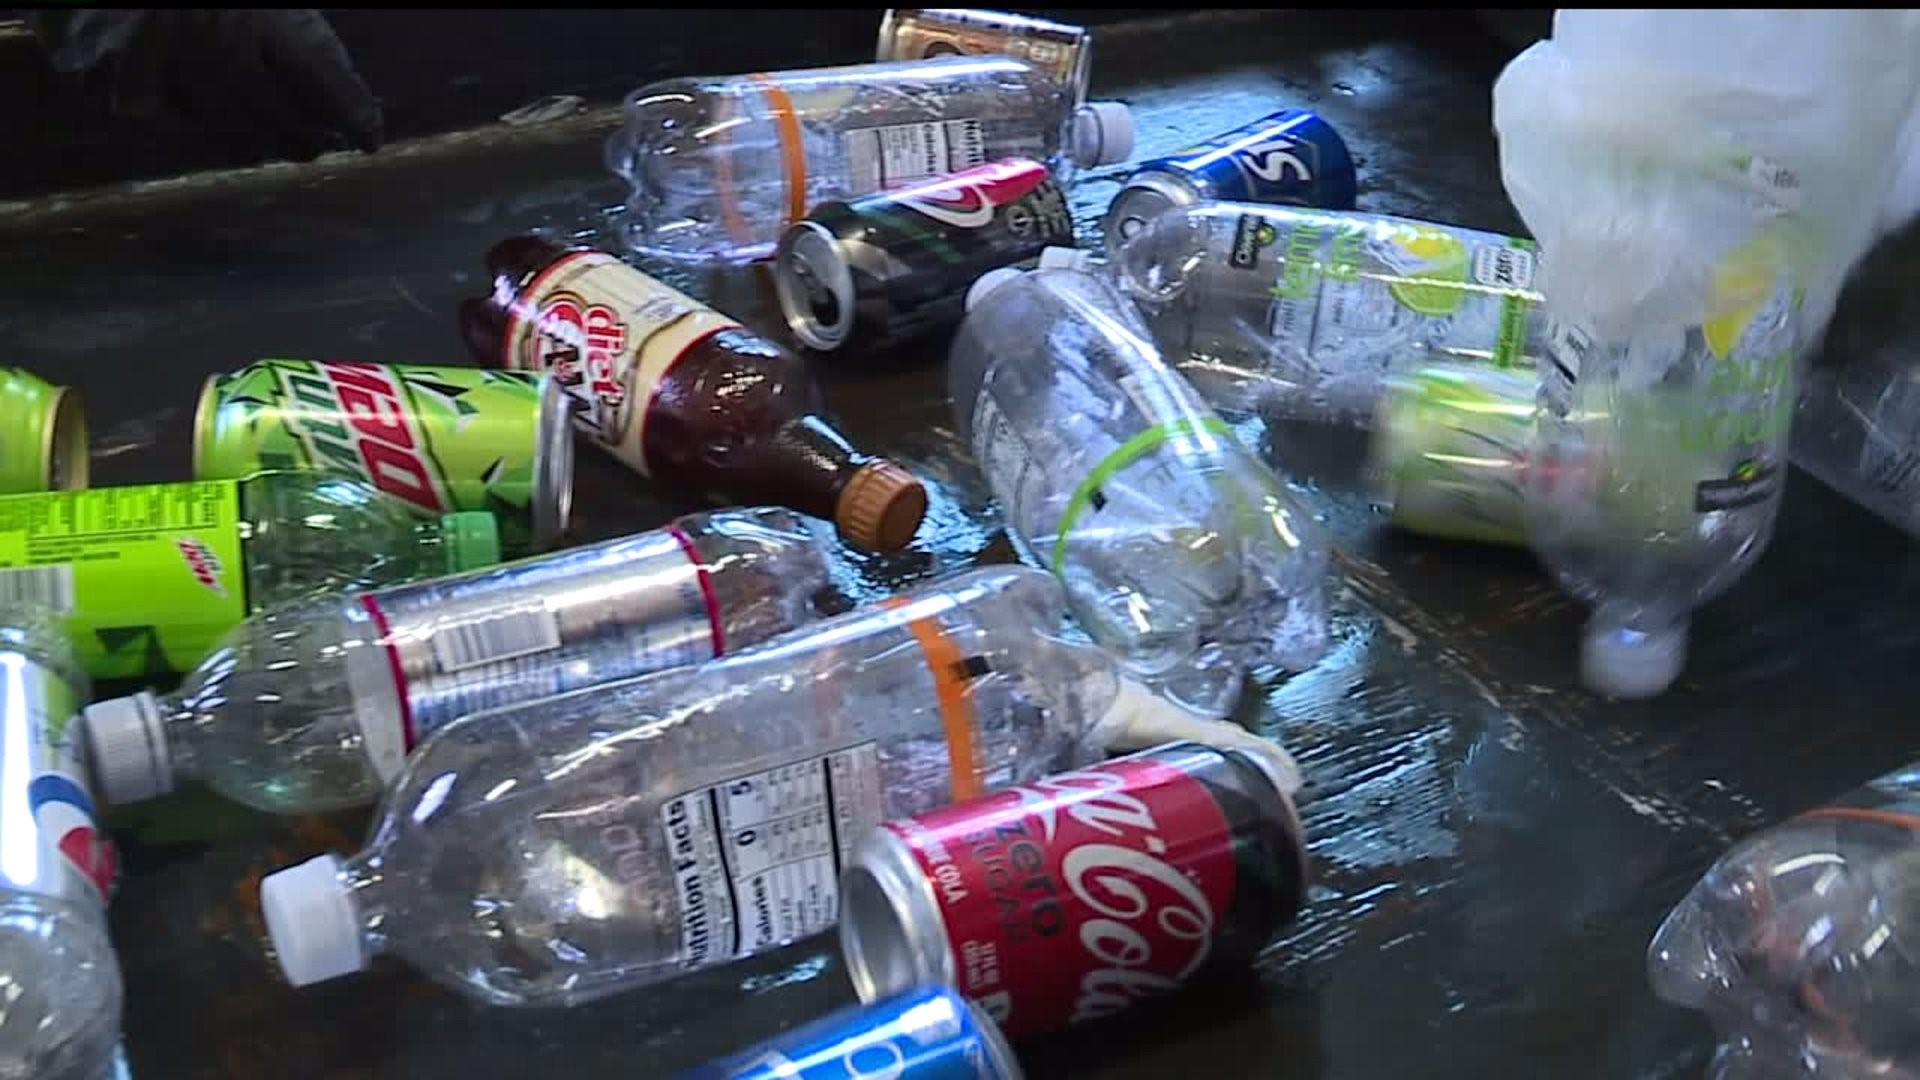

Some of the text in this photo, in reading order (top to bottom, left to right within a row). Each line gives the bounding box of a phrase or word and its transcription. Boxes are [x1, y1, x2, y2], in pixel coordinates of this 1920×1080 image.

[587, 305, 625, 398] diet
[668, 801, 696, 871] Facts
[737, 829, 756, 847] 0
[935, 866, 968, 904] COLA
